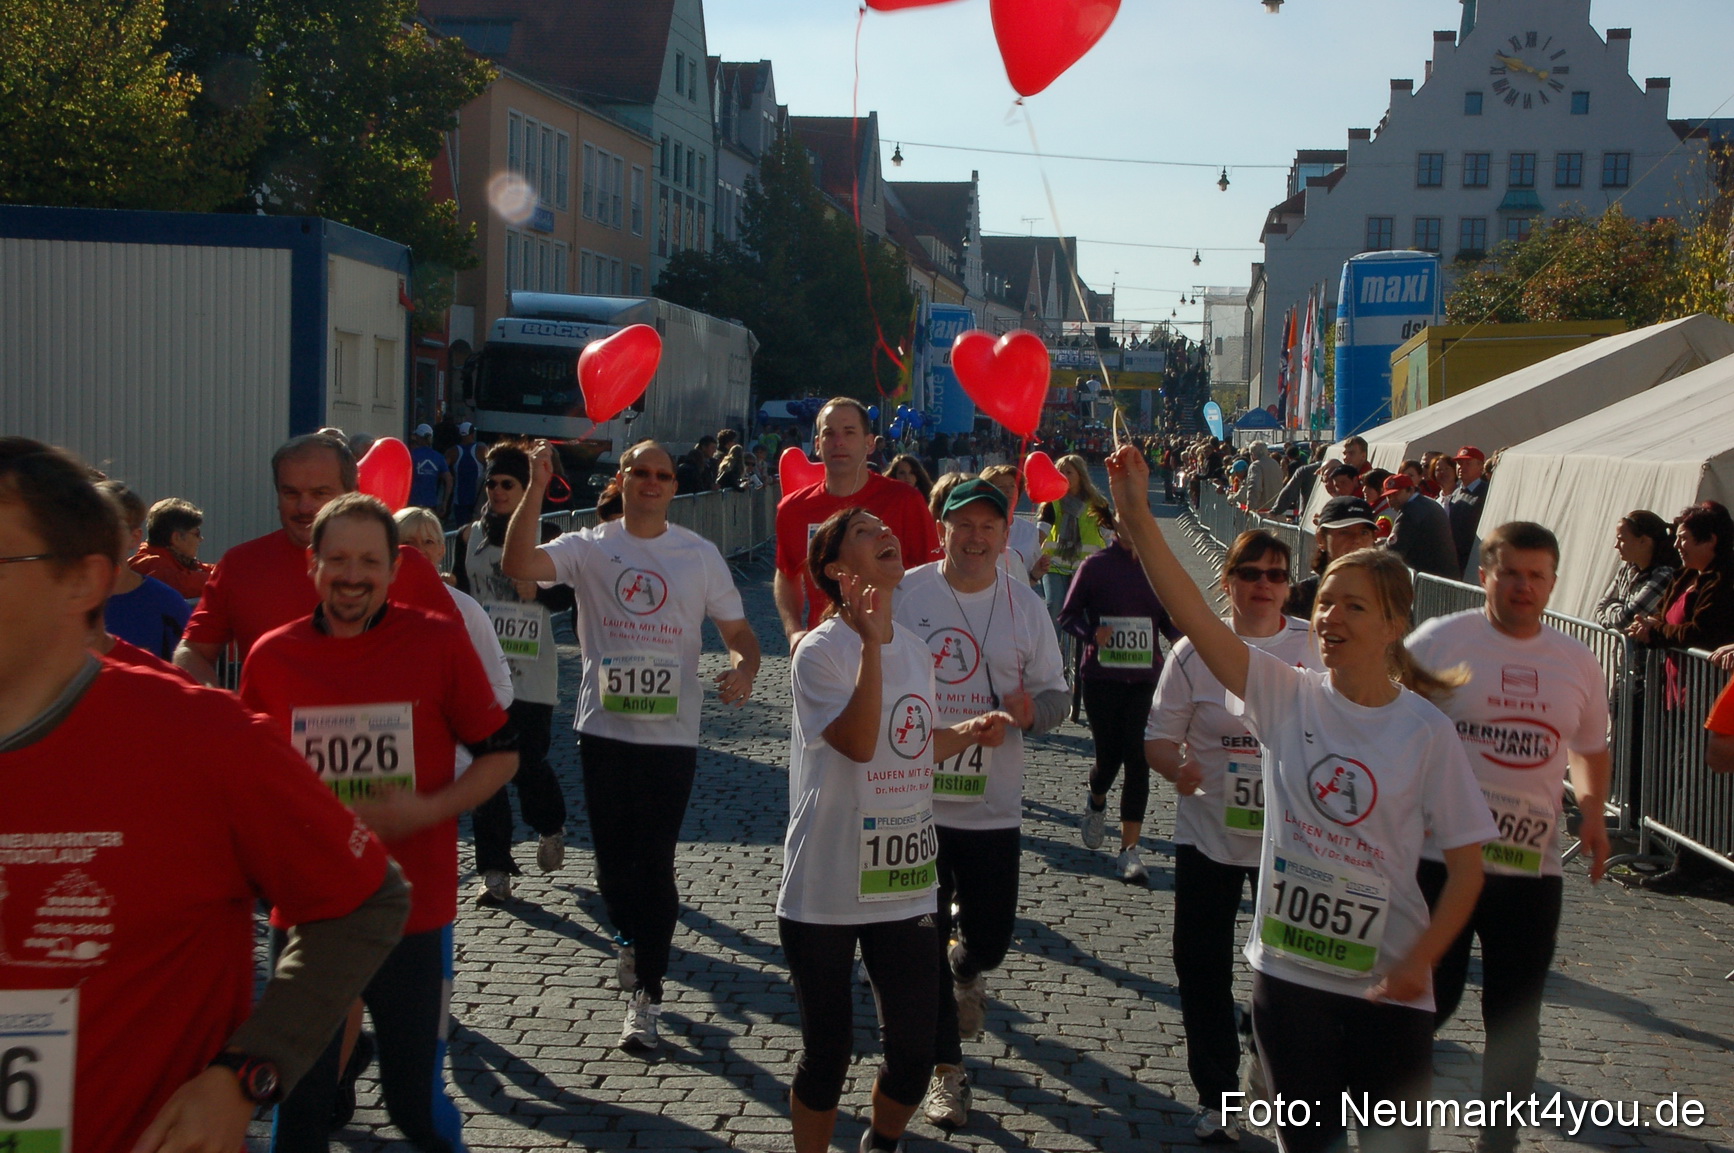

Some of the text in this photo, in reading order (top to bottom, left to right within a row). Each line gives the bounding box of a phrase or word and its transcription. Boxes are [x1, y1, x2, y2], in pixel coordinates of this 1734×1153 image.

[1360, 268, 1429, 304] maxi
[931, 317, 964, 339] axi
[490, 616, 539, 640] 0679
[639, 622, 657, 632] MIT
[660, 623, 683, 636] HERZ
[607, 667, 672, 695] 5192
[622, 697, 657, 714] Andy
[946, 694, 966, 703] MIT
[971, 692, 994, 704] HER
[1456, 721, 1545, 746] GERHART
[304, 733, 399, 774] 5026
[867, 769, 905, 782] LAUFEN
[908, 768, 921, 778] MIT
[934, 776, 980, 792] ristian
[875, 787, 888, 795] Dr.
[888, 784, 906, 793] Heck
[1234, 777, 1266, 808] 50
[877, 813, 917, 827] PFLEIDERER
[866, 823, 937, 867] 10660
[1327, 831, 1352, 849] MIT
[1327, 848, 1342, 862] Dr.
[888, 868, 929, 888] Petra
[1286, 859, 1334, 884] PFLEIDERER
[1273, 879, 1381, 941] 10657
[1283, 924, 1348, 962] Nicole
[0, 1046, 41, 1122] 6
